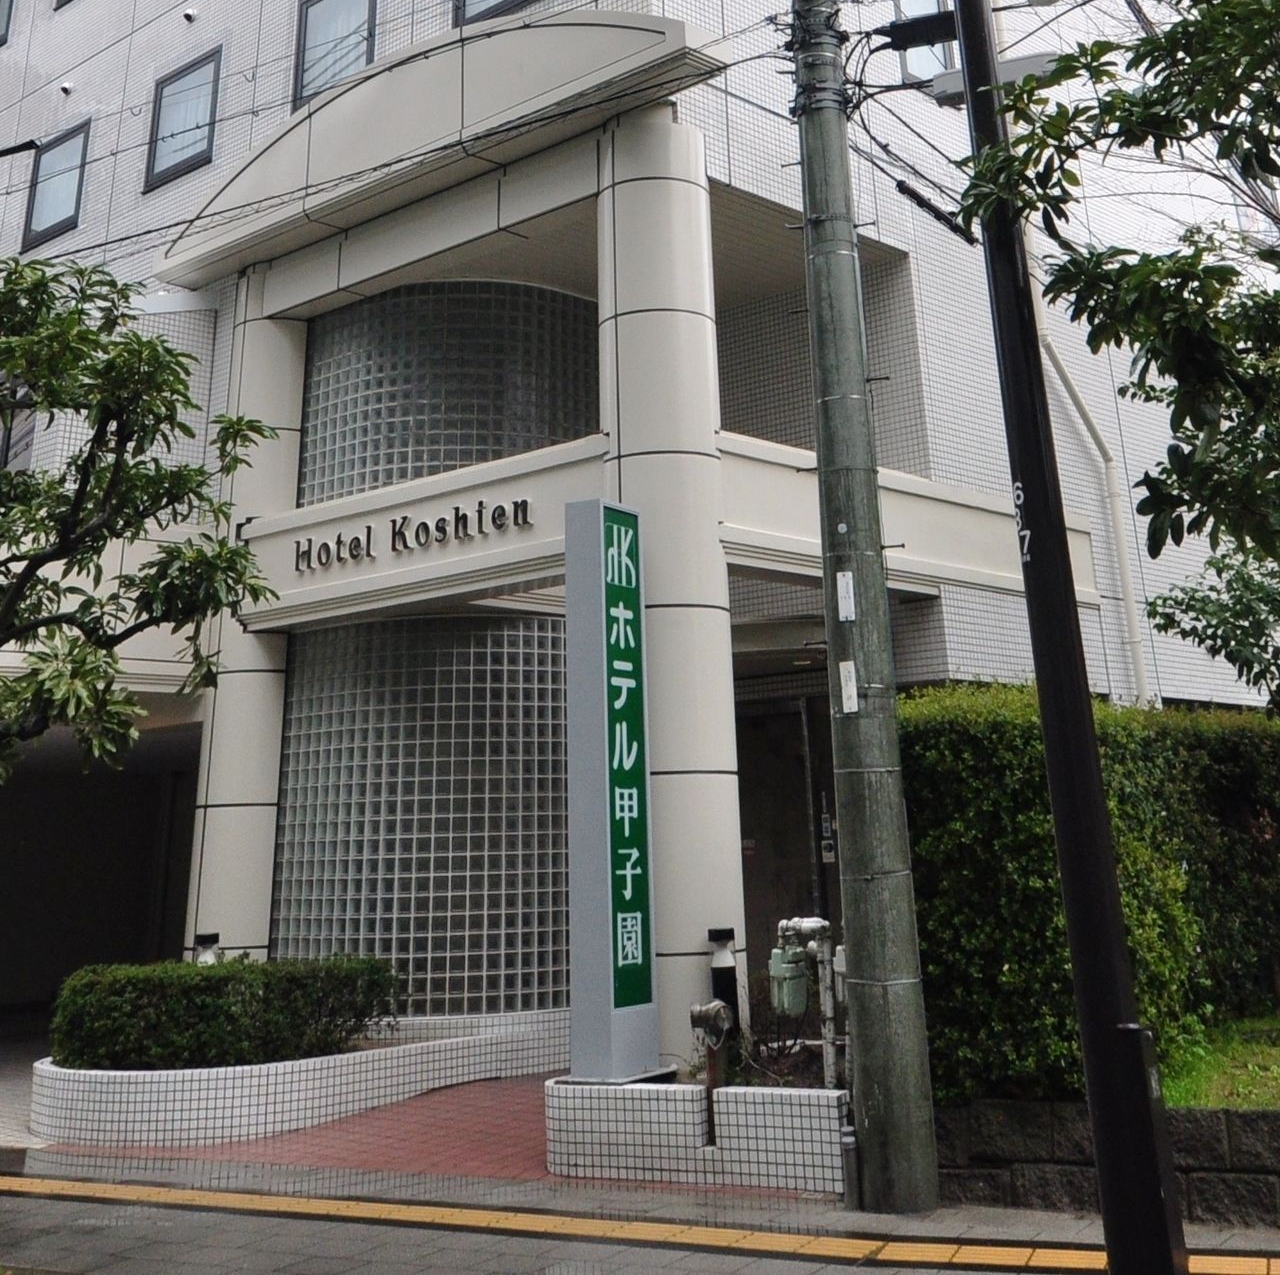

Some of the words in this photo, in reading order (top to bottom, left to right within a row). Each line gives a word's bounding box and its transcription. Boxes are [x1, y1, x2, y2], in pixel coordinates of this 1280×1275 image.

[294, 525, 376, 573] Hotel
[389, 498, 534, 554] Koshien
[609, 601, 643, 969] ホテル甲子園
